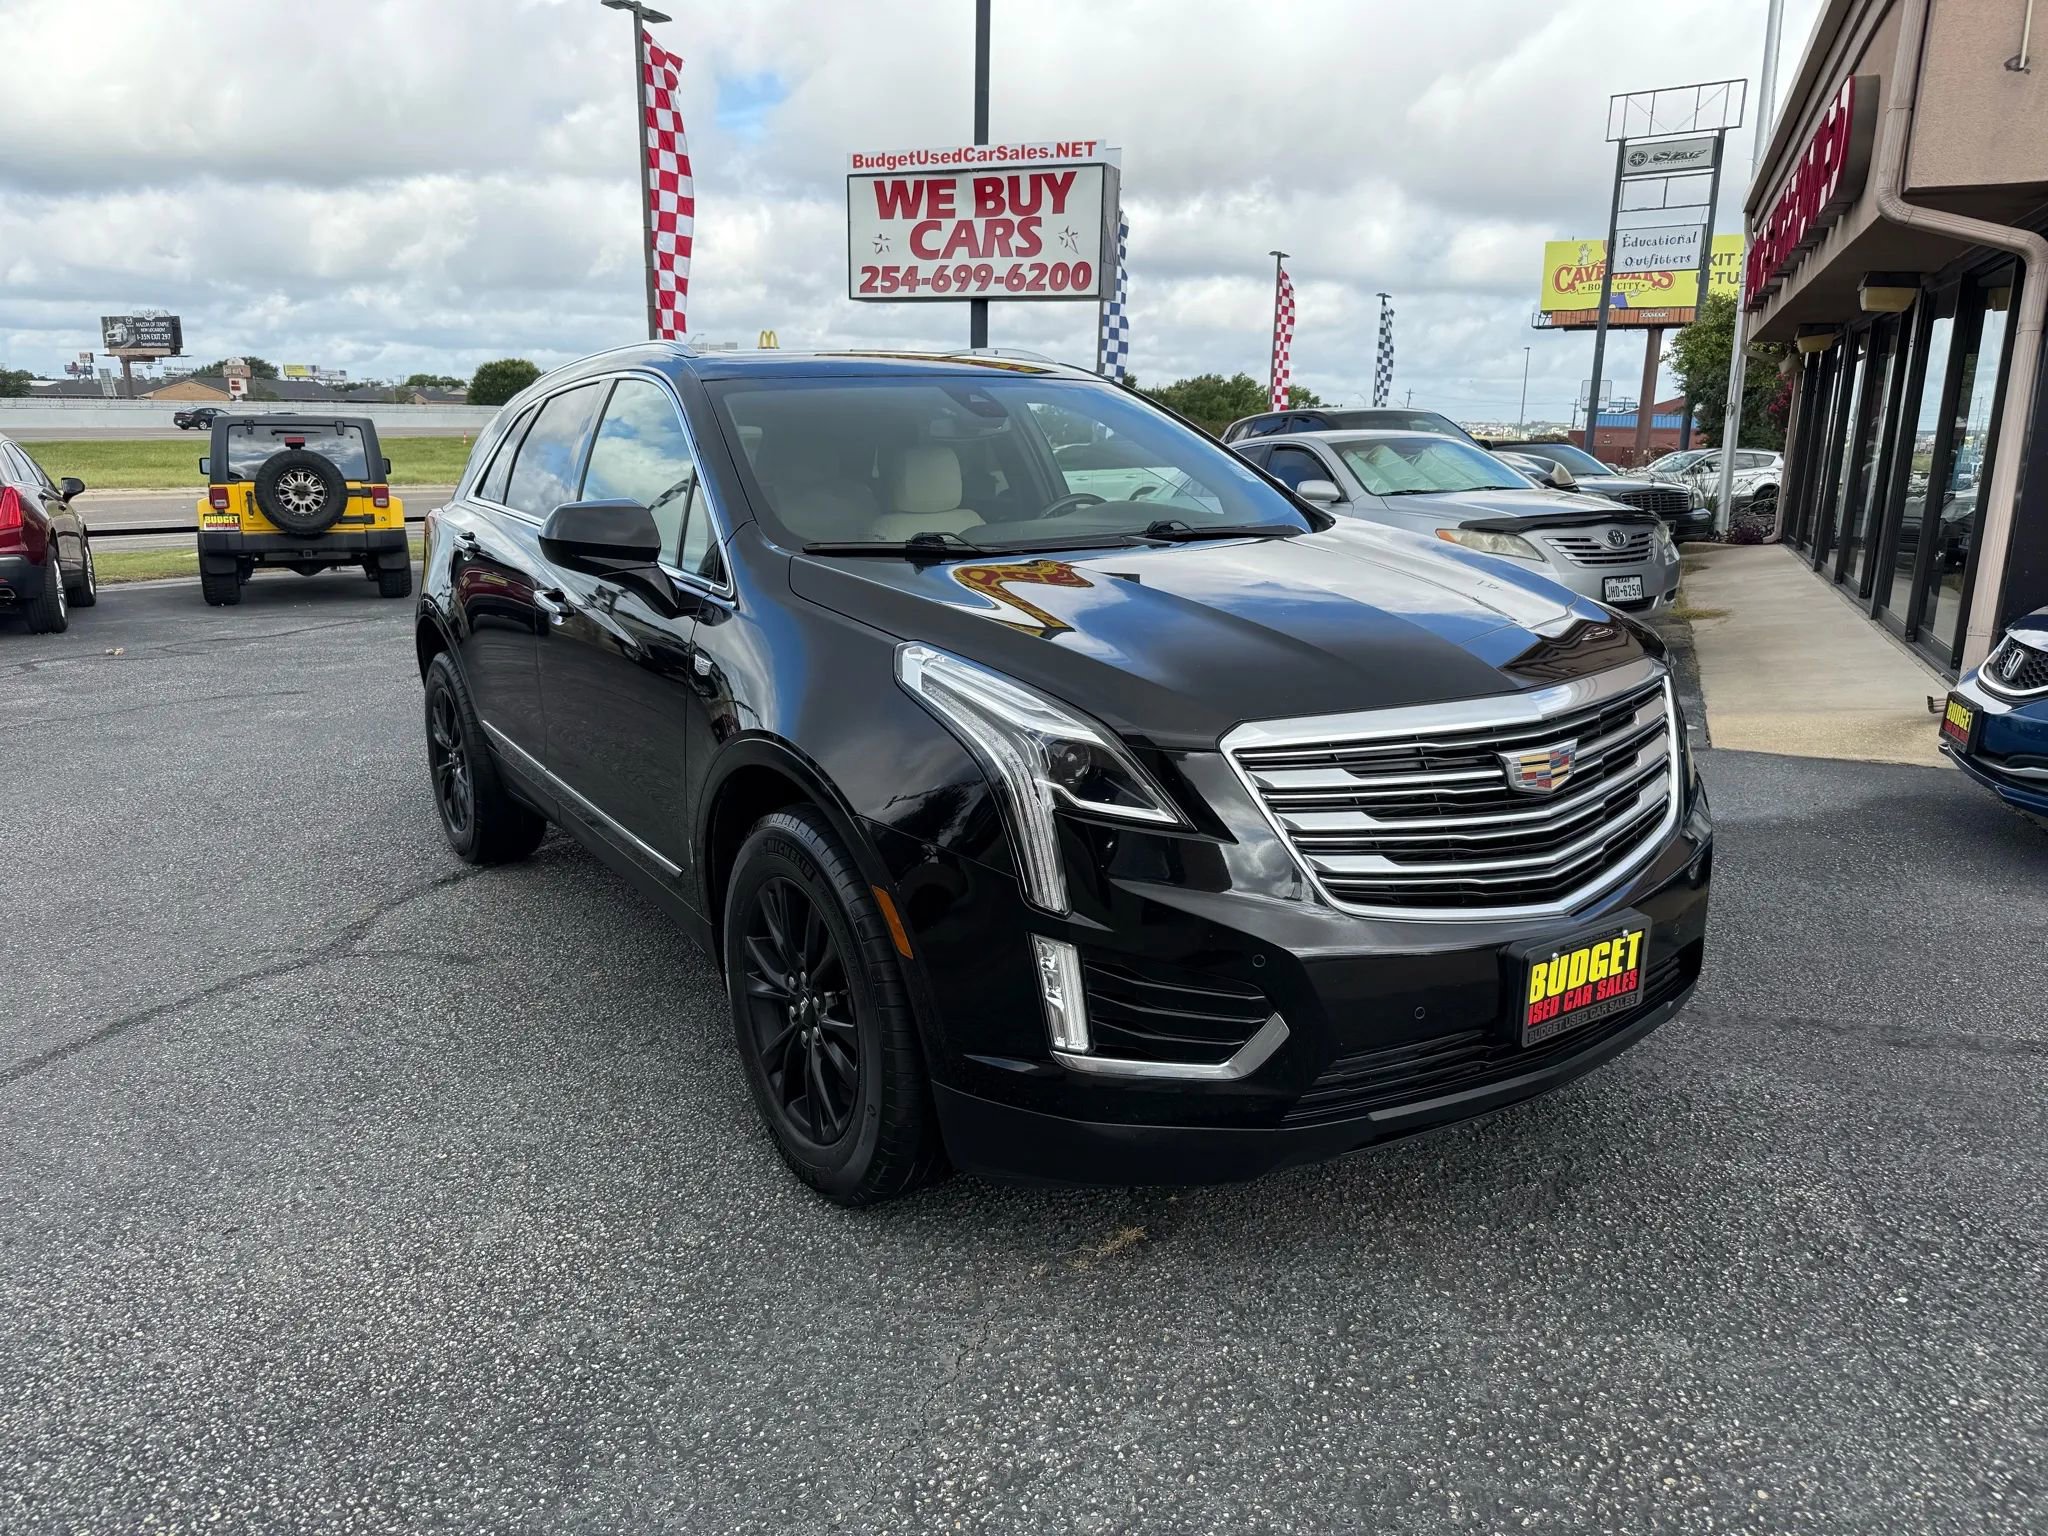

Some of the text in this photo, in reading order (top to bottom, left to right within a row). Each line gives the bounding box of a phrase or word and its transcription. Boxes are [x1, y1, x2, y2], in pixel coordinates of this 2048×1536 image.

[852, 141, 1098, 171] BudgetUsedCarSales.NET
[873, 171, 1078, 220] WE BUY
[909, 216, 1043, 261] CARS
[1622, 231, 1697, 248] Educational
[1623, 254, 1692, 268] Outfitters
[859, 261, 1093, 294] 254-699-6200
[1616, 280, 1641, 291] CITY
[151, 333, 161, 341] EXIT
[204, 515, 240, 524] BUDGET
[1528, 930, 1644, 1005] BUDGET
[1563, 983, 1594, 1013] CAR
[1596, 968, 1638, 1001] SALES
[1528, 994, 1637, 1043] BUDGET USED CAR SALES
